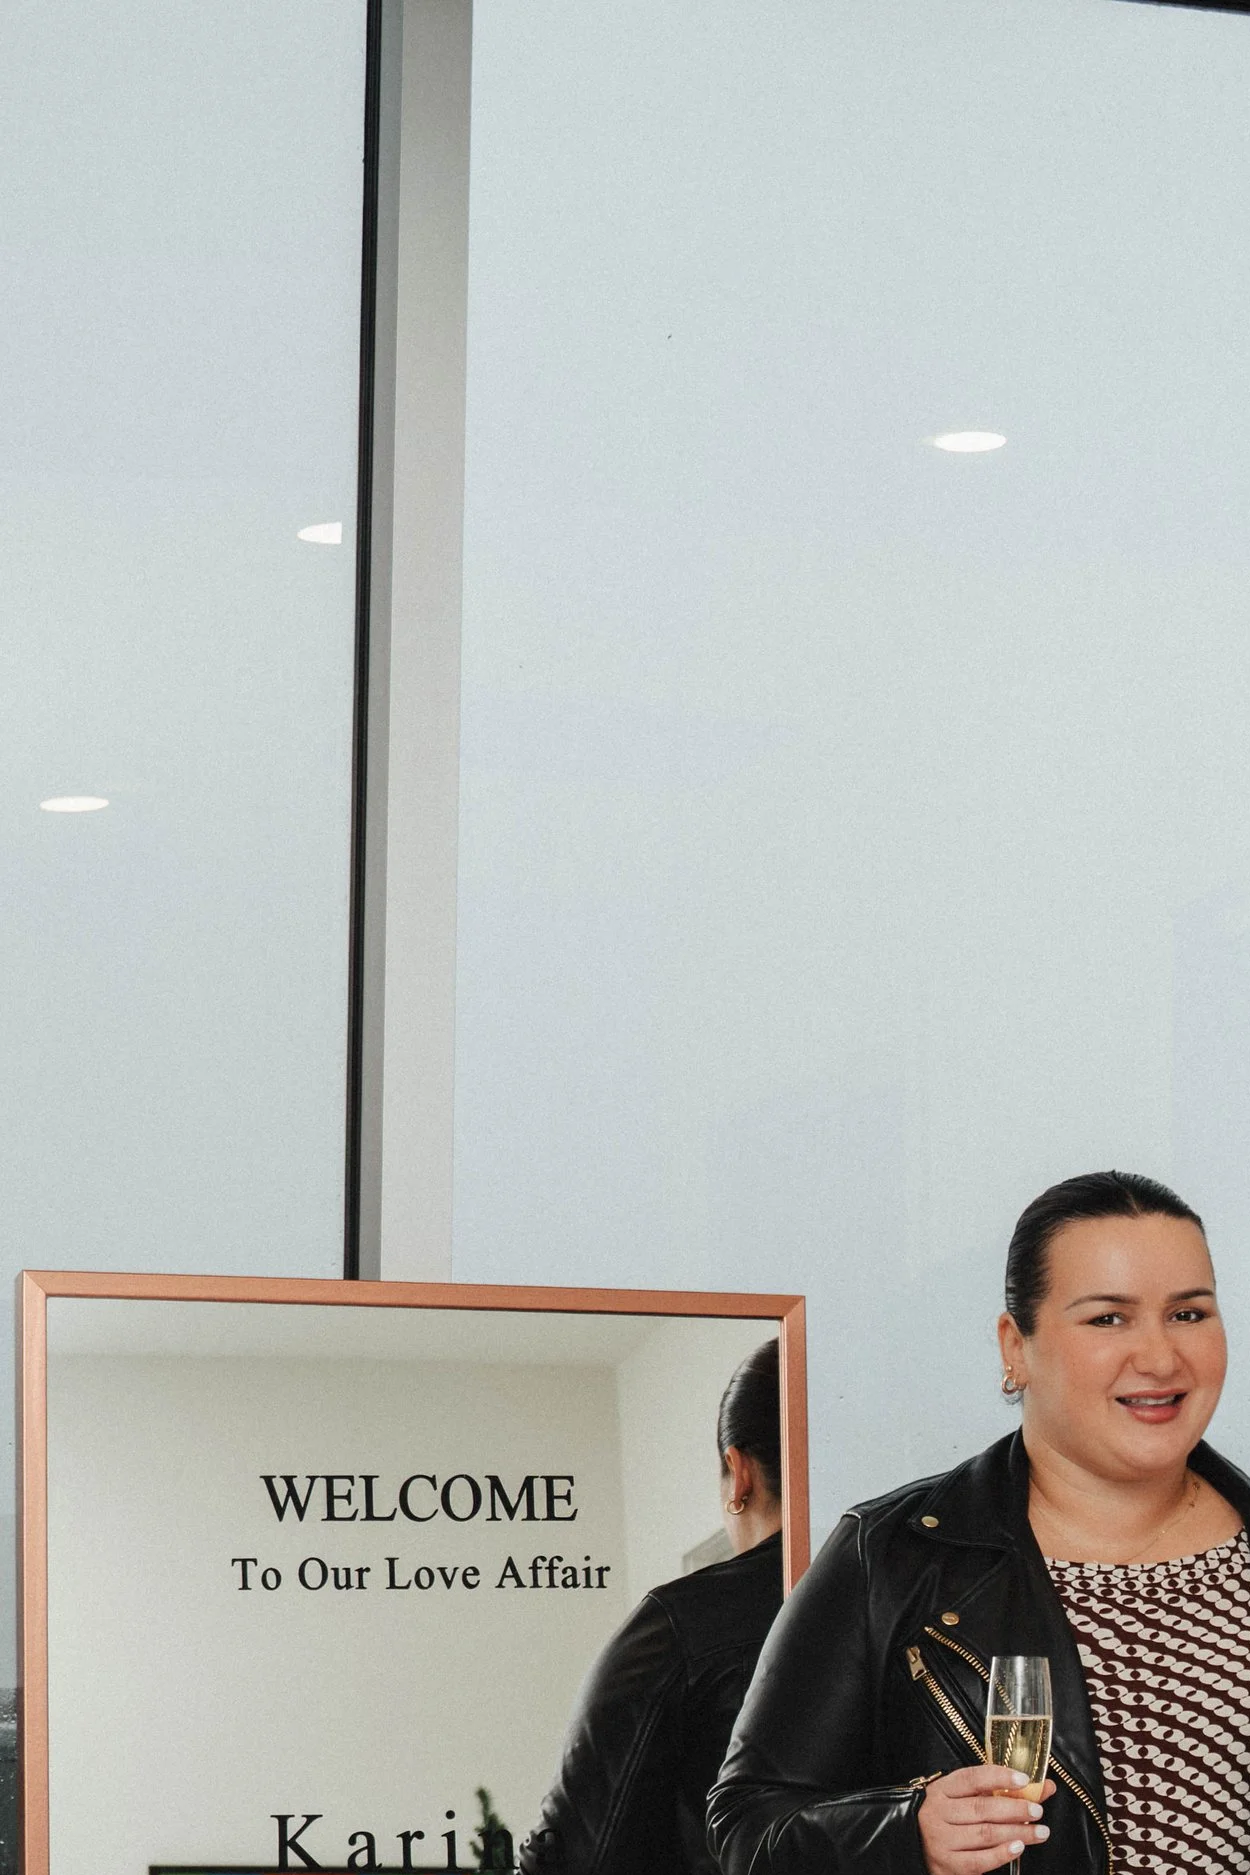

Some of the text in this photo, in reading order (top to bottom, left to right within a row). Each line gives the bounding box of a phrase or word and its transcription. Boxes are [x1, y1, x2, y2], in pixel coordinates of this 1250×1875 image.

[259, 1473, 578, 1523] WELCOME
[231, 1555, 611, 1591] To Our Love Affair
